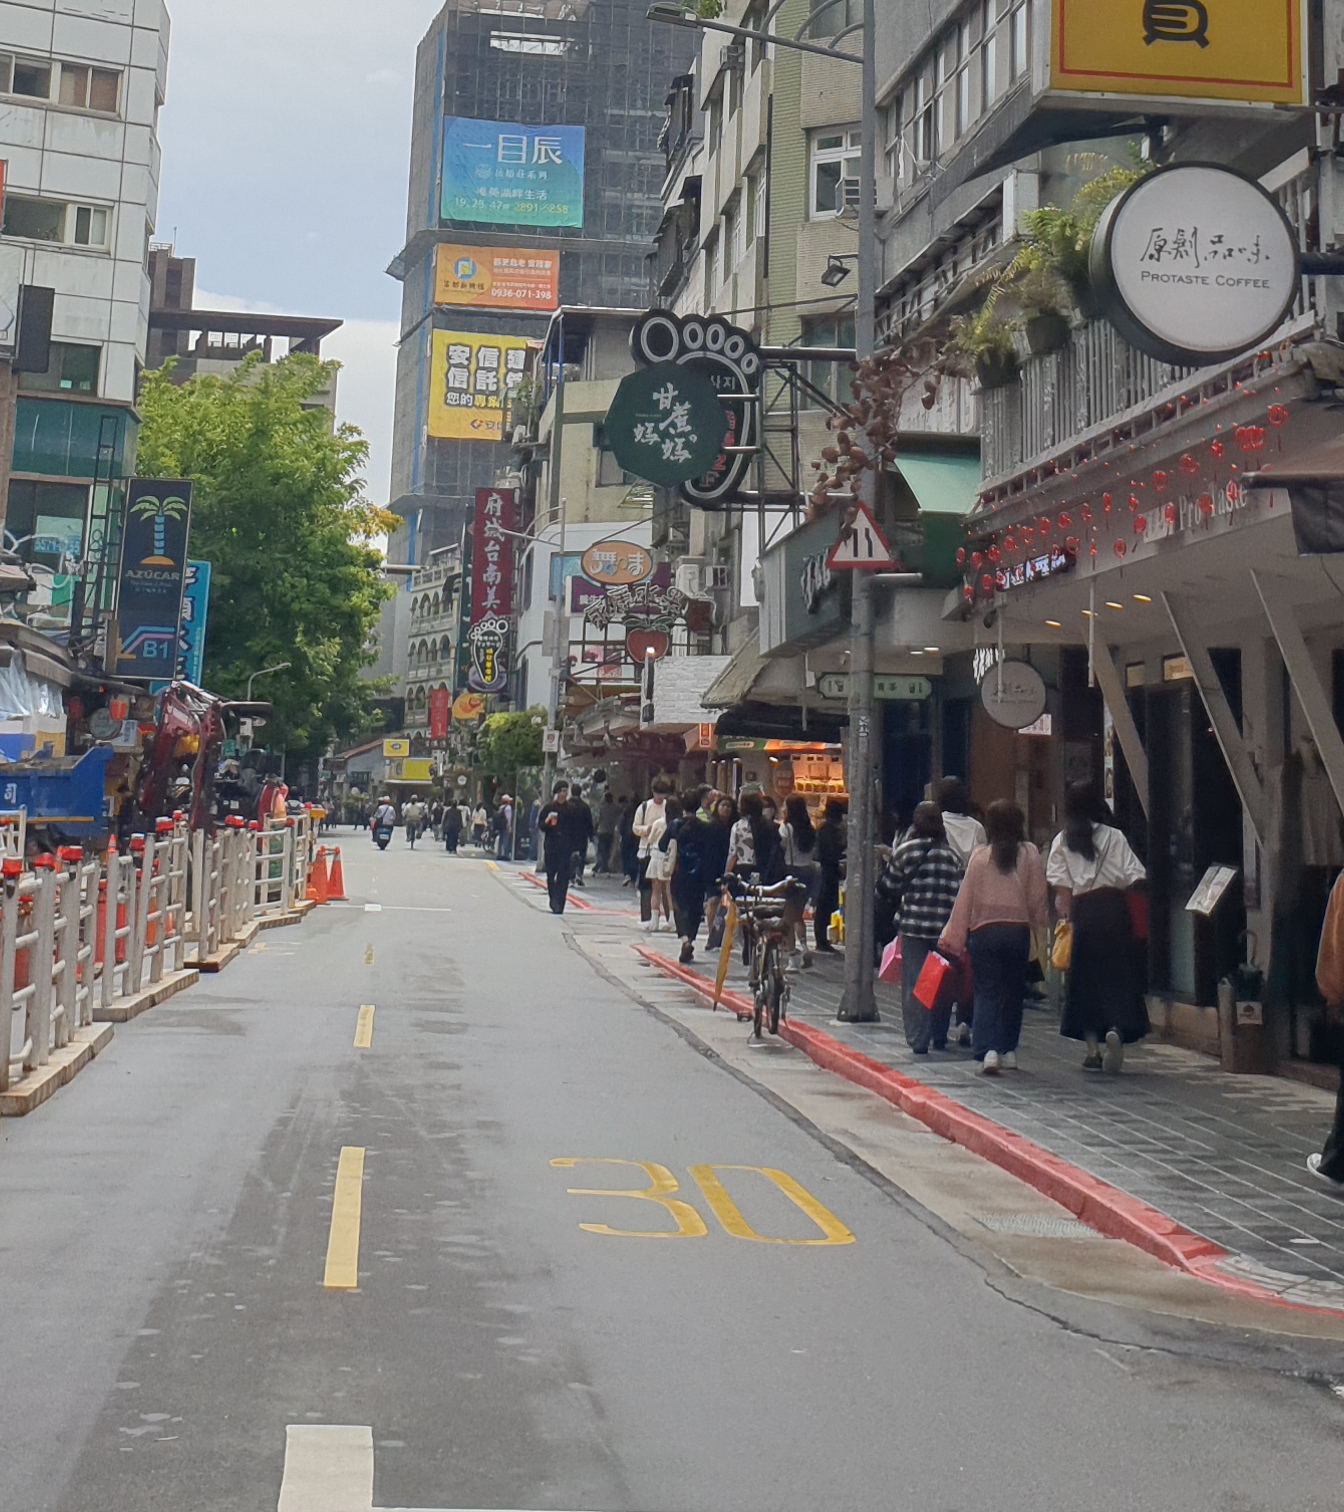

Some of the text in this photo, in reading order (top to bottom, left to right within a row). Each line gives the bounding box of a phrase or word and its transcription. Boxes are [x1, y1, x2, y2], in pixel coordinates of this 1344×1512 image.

[482, 492, 506, 619] 府城台南美
[143, 640, 169, 659] B1
[549, 1158, 856, 1245] 30
